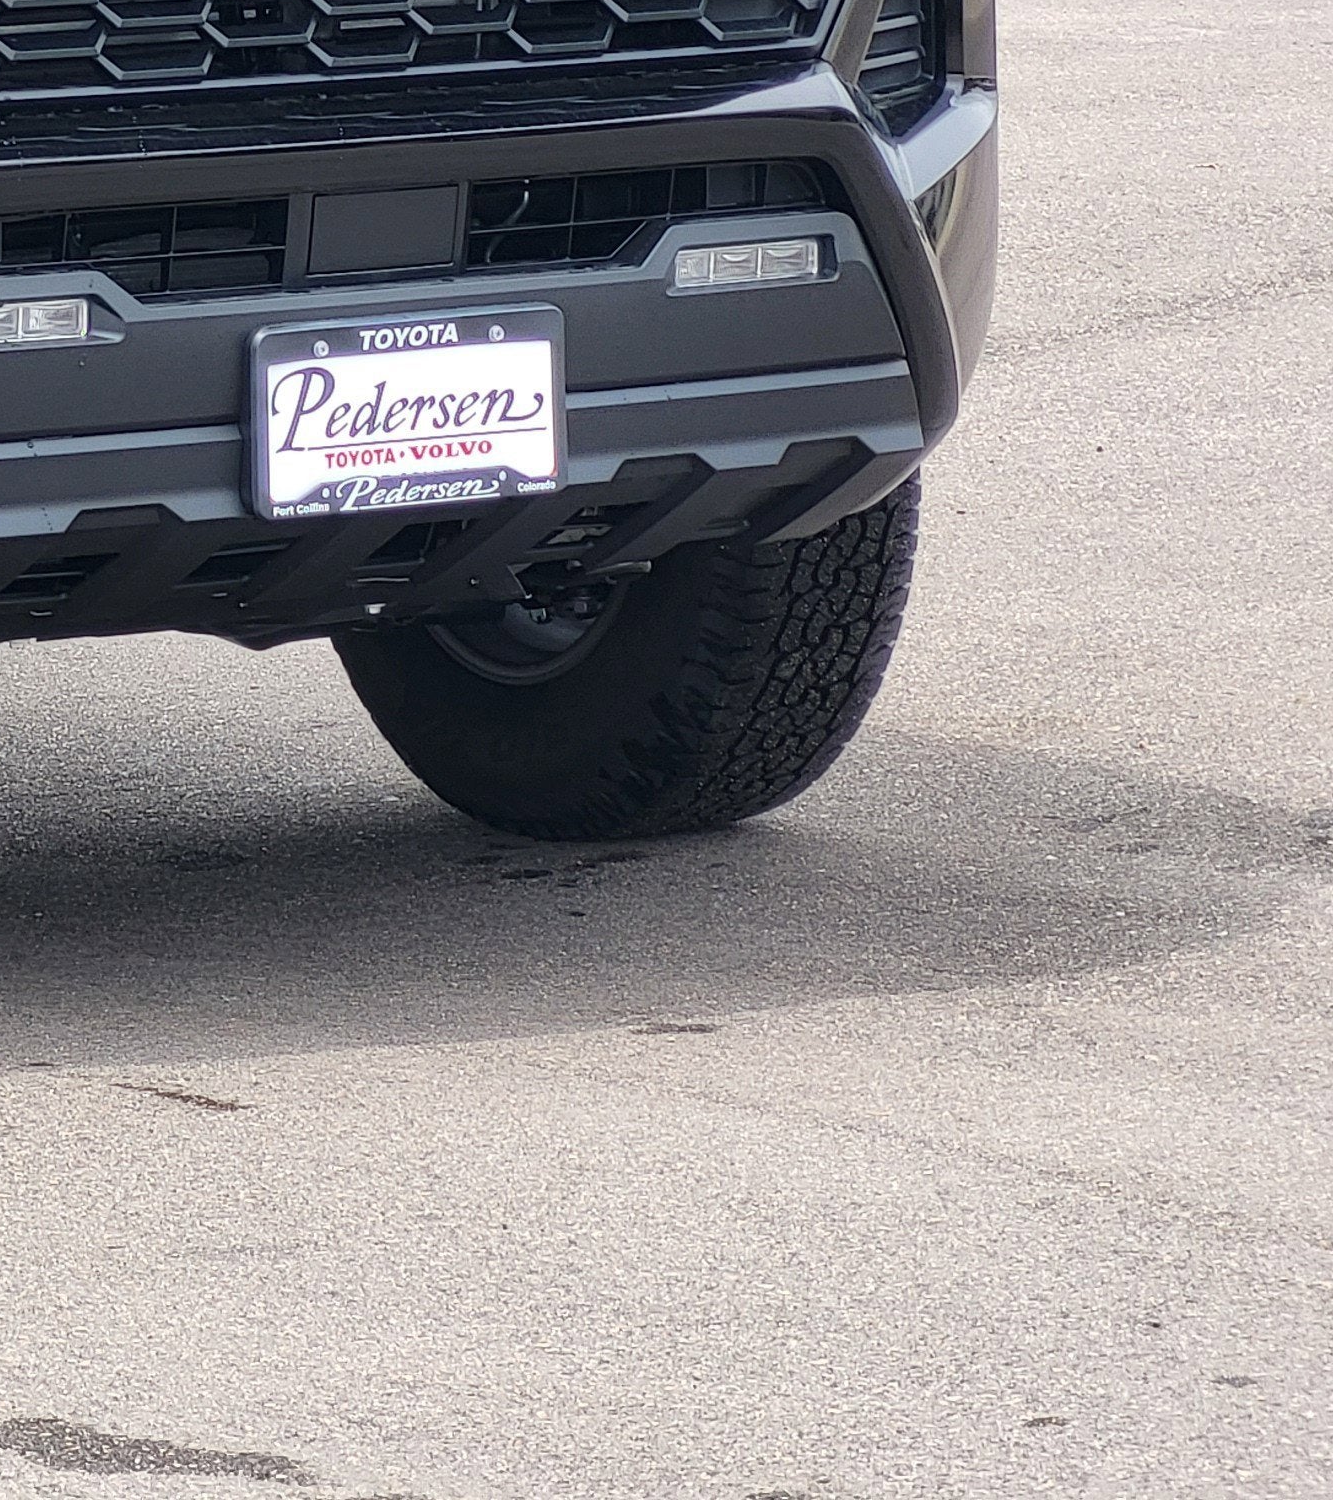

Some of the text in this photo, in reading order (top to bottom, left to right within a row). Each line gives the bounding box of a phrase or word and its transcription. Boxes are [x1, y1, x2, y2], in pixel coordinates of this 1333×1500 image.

[358, 322, 459, 352] TOYOTA
[271, 365, 545, 454] Pedersen
[324, 440, 493, 470] TOYOTA VOLVO
[335, 474, 501, 512] Pedersen
[516, 479, 557, 493] Colorado
[272, 505, 295, 518] Fort
